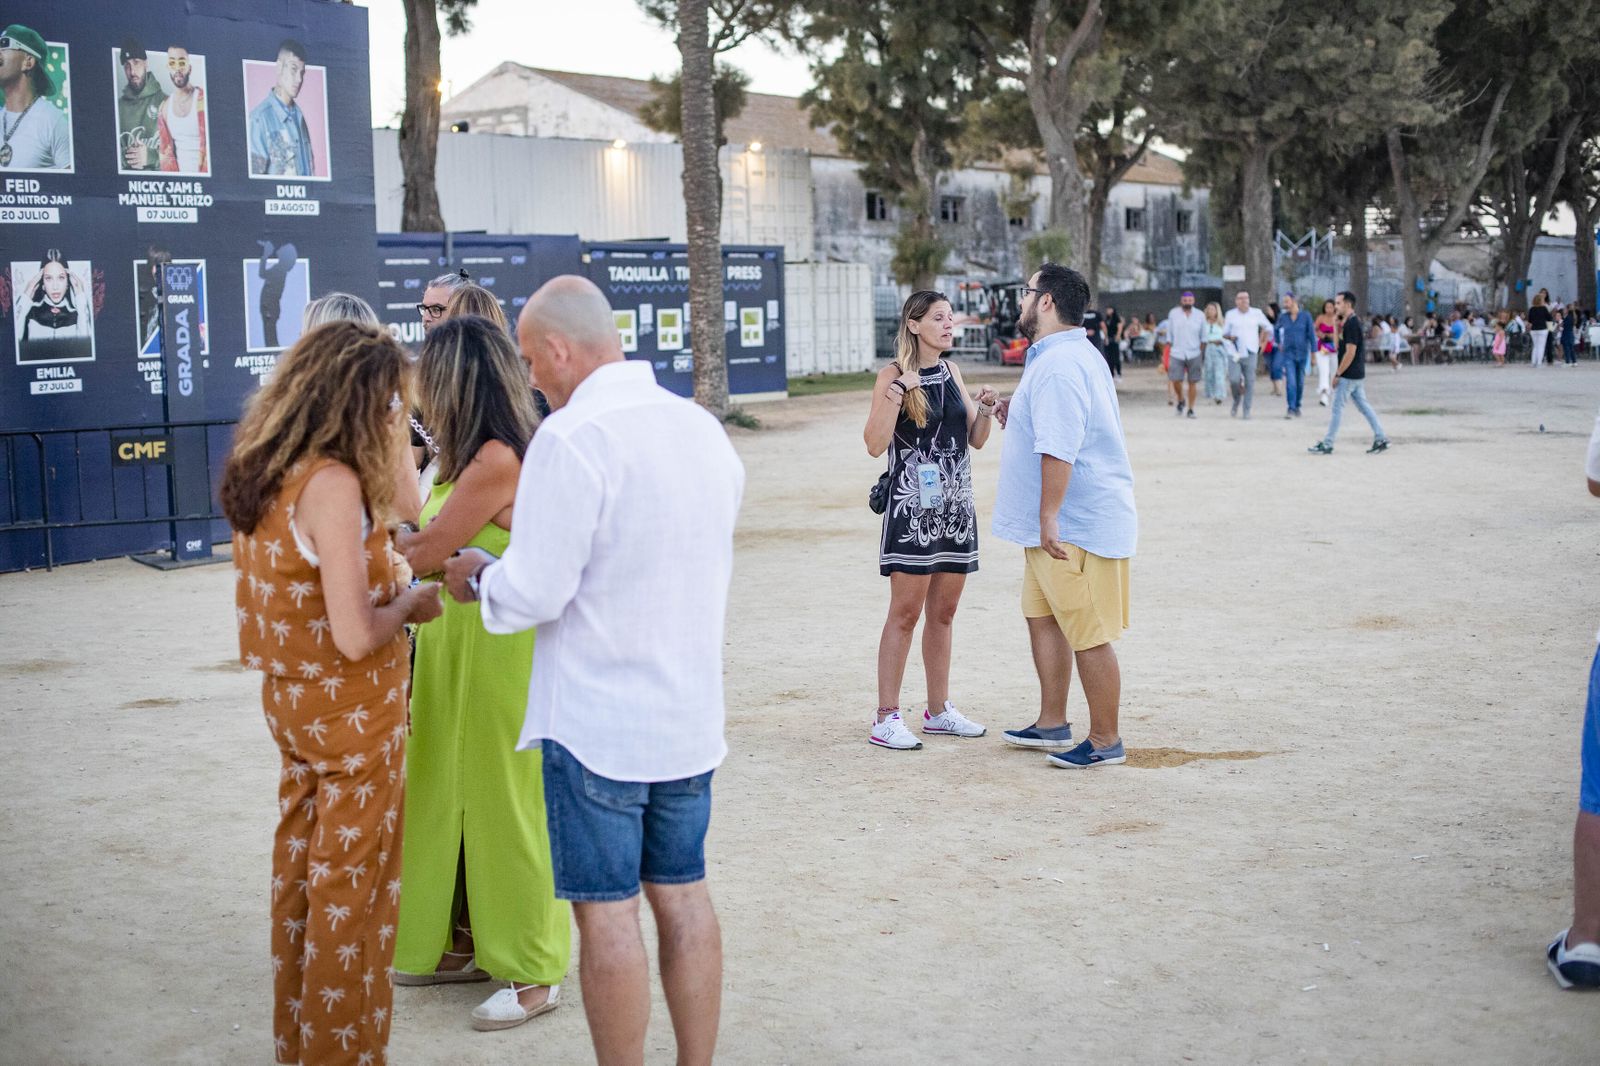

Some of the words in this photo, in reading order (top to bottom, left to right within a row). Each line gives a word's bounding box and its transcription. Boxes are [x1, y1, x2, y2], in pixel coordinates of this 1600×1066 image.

[5, 179, 40, 193] FEID
[128, 181, 165, 194] NICKY
[165, 182, 192, 194] JAM
[193, 182, 203, 194] &
[276, 185, 307, 198] DUKI
[17, 194, 48, 205] NITRO
[49, 195, 72, 205] JAM
[118, 193, 170, 206] MANUEL
[170, 194, 213, 207] TURIZO
[269, 203, 279, 212] 19
[280, 203, 315, 212] AGOSTO
[1, 210, 15, 220] 20
[17, 210, 50, 220] JULIO
[146, 210, 158, 219] 07
[159, 210, 189, 220] JULIO
[608, 266, 669, 281] TAQUILLA
[727, 265, 762, 280] PRESS
[167, 295, 195, 304] GRADA
[175, 308, 193, 396] GRADA
[234, 355, 276, 368] ARTISTA
[36, 366, 76, 379] EMILIA
[49, 382, 74, 391] JULIO
[118, 441, 166, 460] CMF
